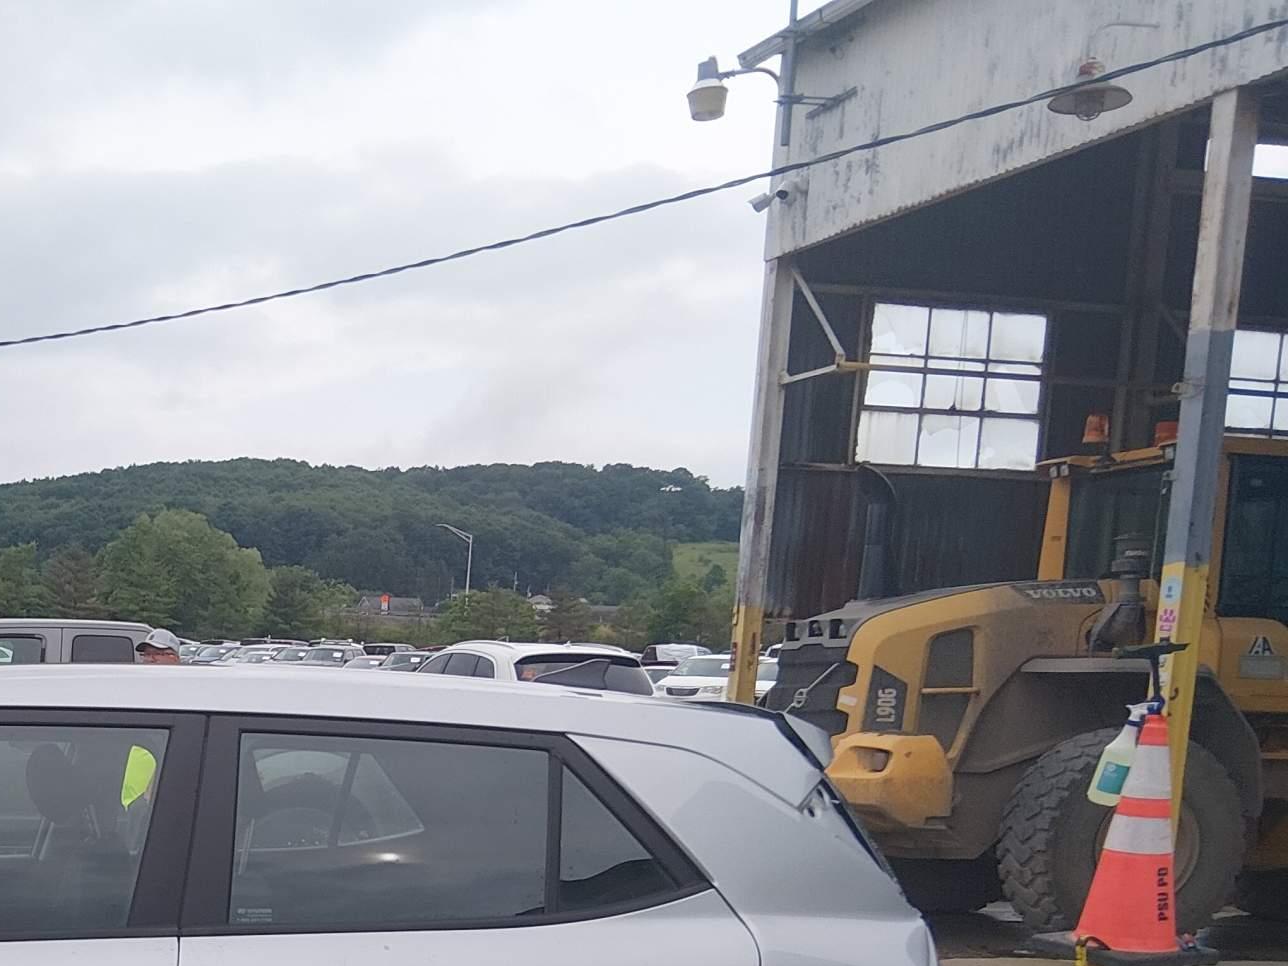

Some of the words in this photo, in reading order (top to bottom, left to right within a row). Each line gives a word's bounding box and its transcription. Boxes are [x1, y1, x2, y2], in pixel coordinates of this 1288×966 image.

[1023, 587, 1097, 599] VOLVO
[875, 688, 897, 722] L90G
[1157, 892, 1169, 922] PSU
